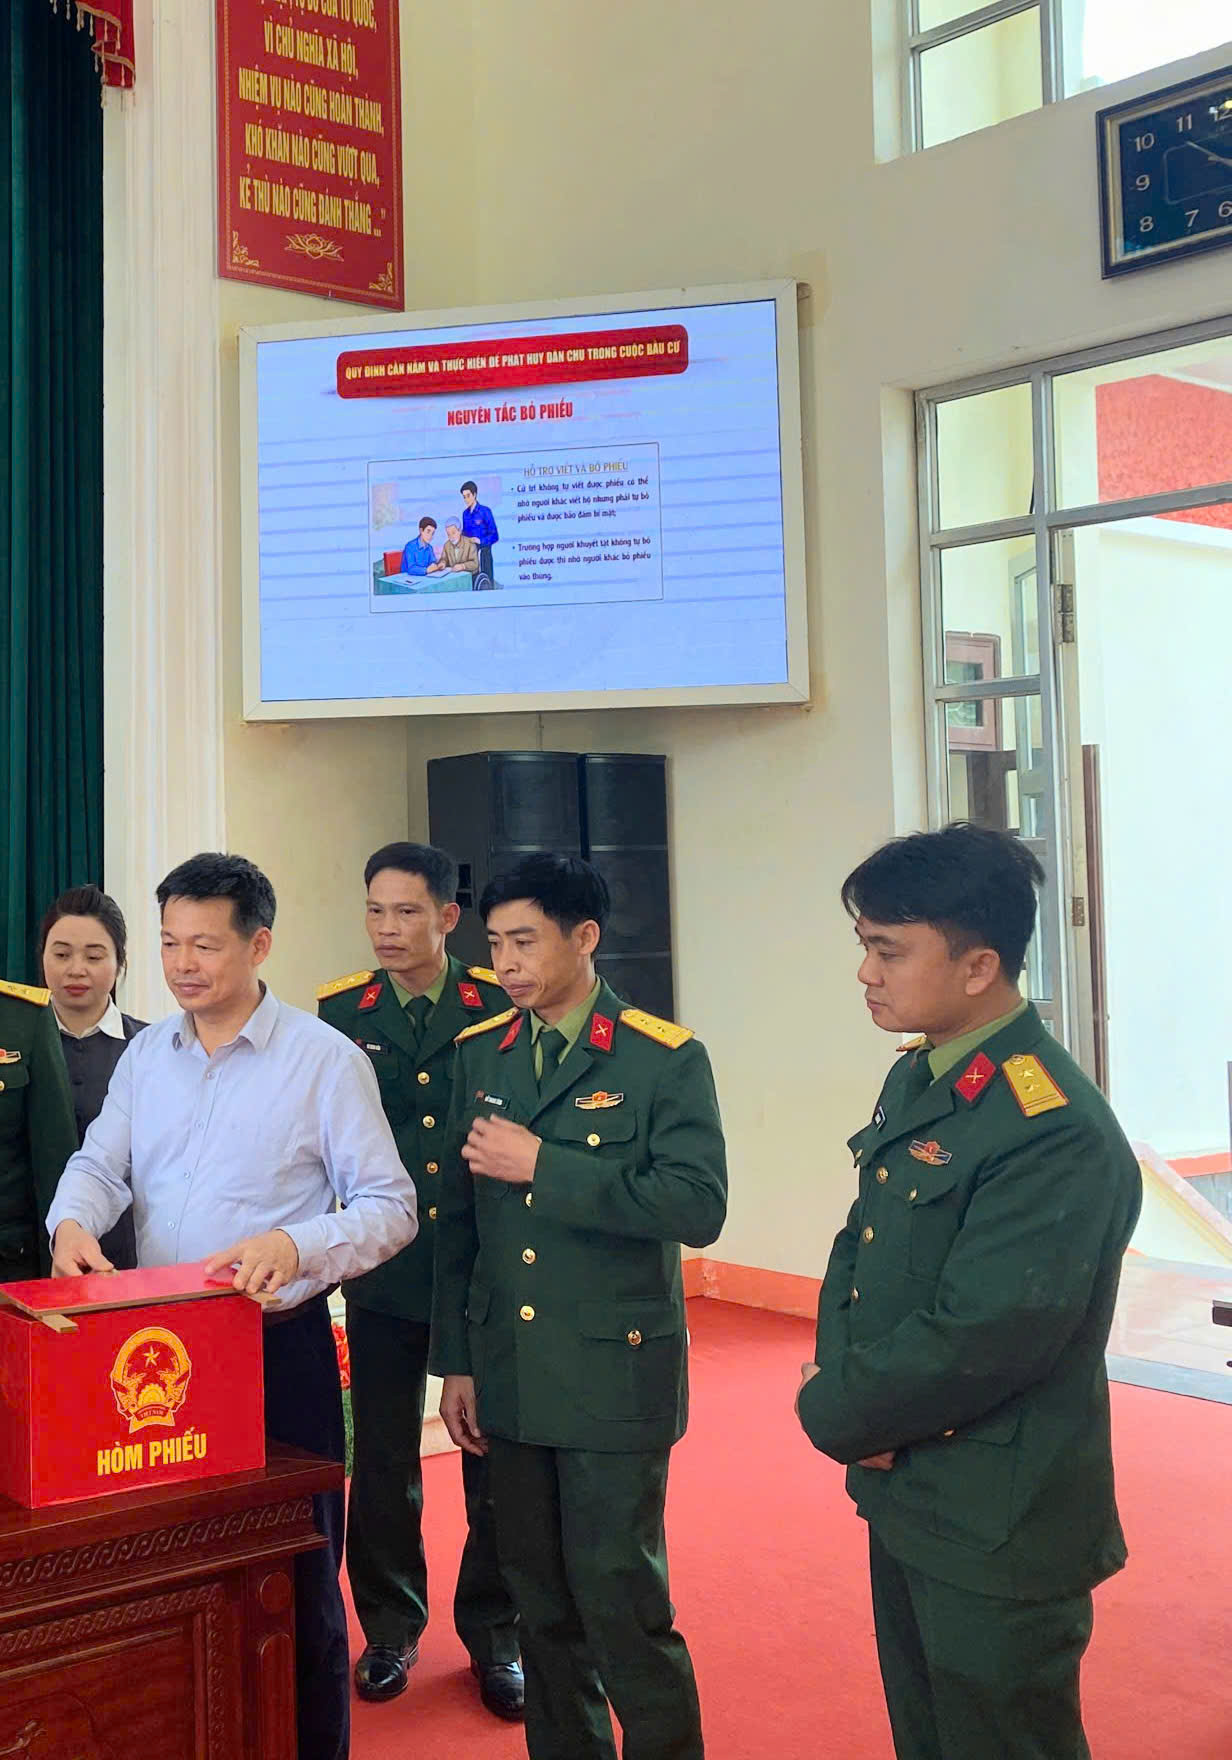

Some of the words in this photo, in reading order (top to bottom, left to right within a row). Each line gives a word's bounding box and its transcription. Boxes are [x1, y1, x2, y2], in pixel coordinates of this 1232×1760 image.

[276, 17, 294, 59] CHỦ
[296, 28, 325, 68] NGHĨA
[239, 64, 268, 110] NHIỆM
[269, 74, 282, 116] VỤ
[283, 73, 302, 114] NÀO
[304, 79, 328, 120] CŨNG
[329, 86, 353, 126] HOÀN
[1176, 114, 1193, 132] 11
[245, 118, 263, 158] KHÓ
[265, 122, 289, 164] KHĂN
[291, 128, 310, 169] NÀO
[312, 133, 336, 175] CŨNG
[1134, 132, 1155, 152] 10
[1135, 174, 1150, 191] 9
[253, 174, 270, 214] THÙ
[272, 177, 291, 218] NÀO
[293, 182, 317, 224] CŨNG
[344, 191, 372, 235] THẮNG
[1185, 209, 1199, 228] 7
[1218, 200, 1232, 218] 6
[1139, 216, 1154, 233] 8
[345, 366, 362, 380] QUY
[526, 352, 544, 365] HUY
[587, 346, 617, 360] TRONG
[447, 405, 491, 426] NGUYÊN
[494, 401, 517, 422] TẮC
[520, 400, 536, 421] BỎ
[539, 396, 573, 419] PHIẾU
[97, 1441, 143, 1476] HÒM
[149, 1426, 207, 1467] PHIẾU
